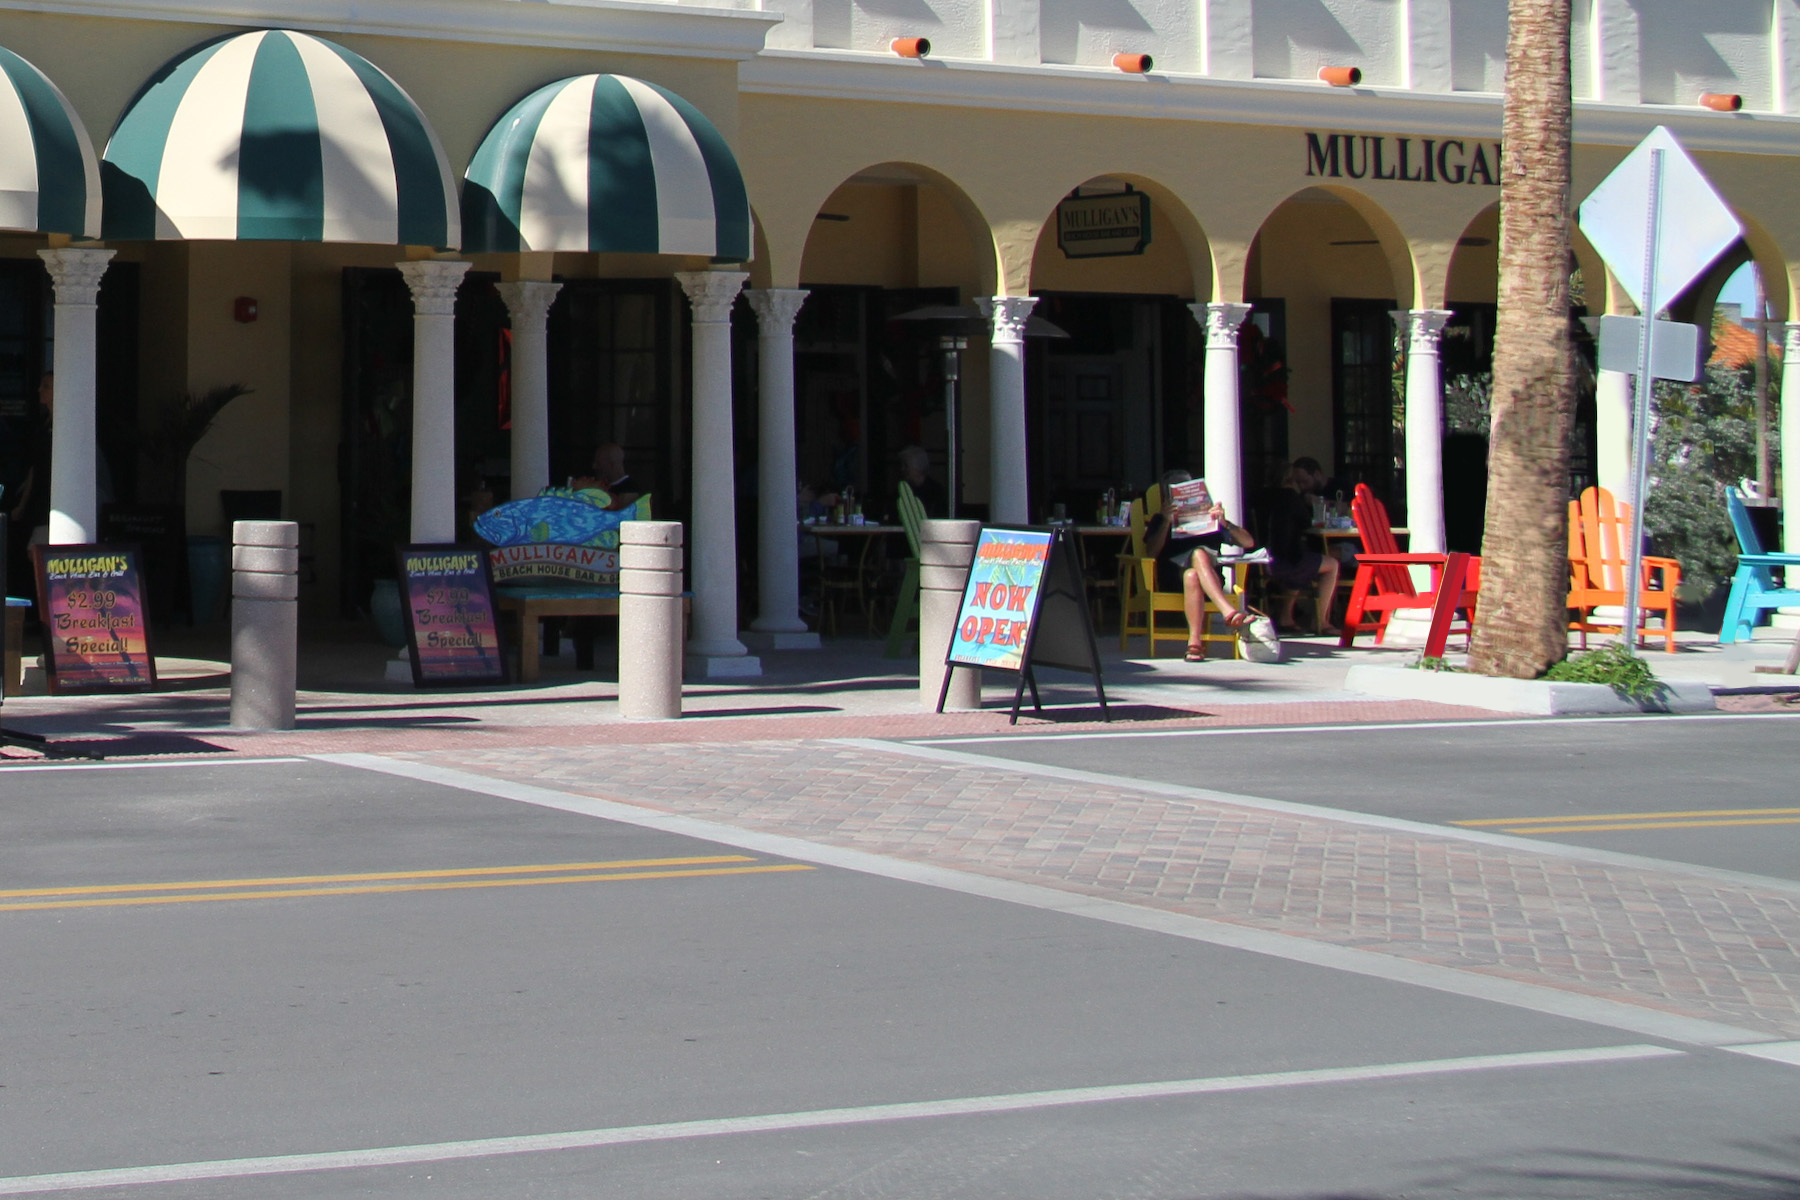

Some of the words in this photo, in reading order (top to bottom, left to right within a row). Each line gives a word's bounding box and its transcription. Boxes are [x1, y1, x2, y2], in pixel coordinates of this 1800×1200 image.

[1305, 132, 1503, 186] MULLIGA
[1064, 206, 1140, 229] MULLIGAN'S
[47, 556, 128, 574] MULLIGAN'S
[406, 555, 478, 571] MULLIGAN'S
[490, 545, 617, 569] MULLIGAN'S
[499, 565, 534, 579] BEACH
[537, 565, 571, 578] HOUSE
[575, 569, 595, 582] BAR
[67, 590, 116, 609] $2.99
[426, 587, 470, 605] $2.99
[969, 581, 1032, 611] NOW
[53, 612, 135, 631] Breakfast
[415, 609, 486, 626] Breakfast
[427, 632, 482, 648] Special!
[961, 615, 1027, 648] OPEN
[65, 636, 128, 655] Special!
